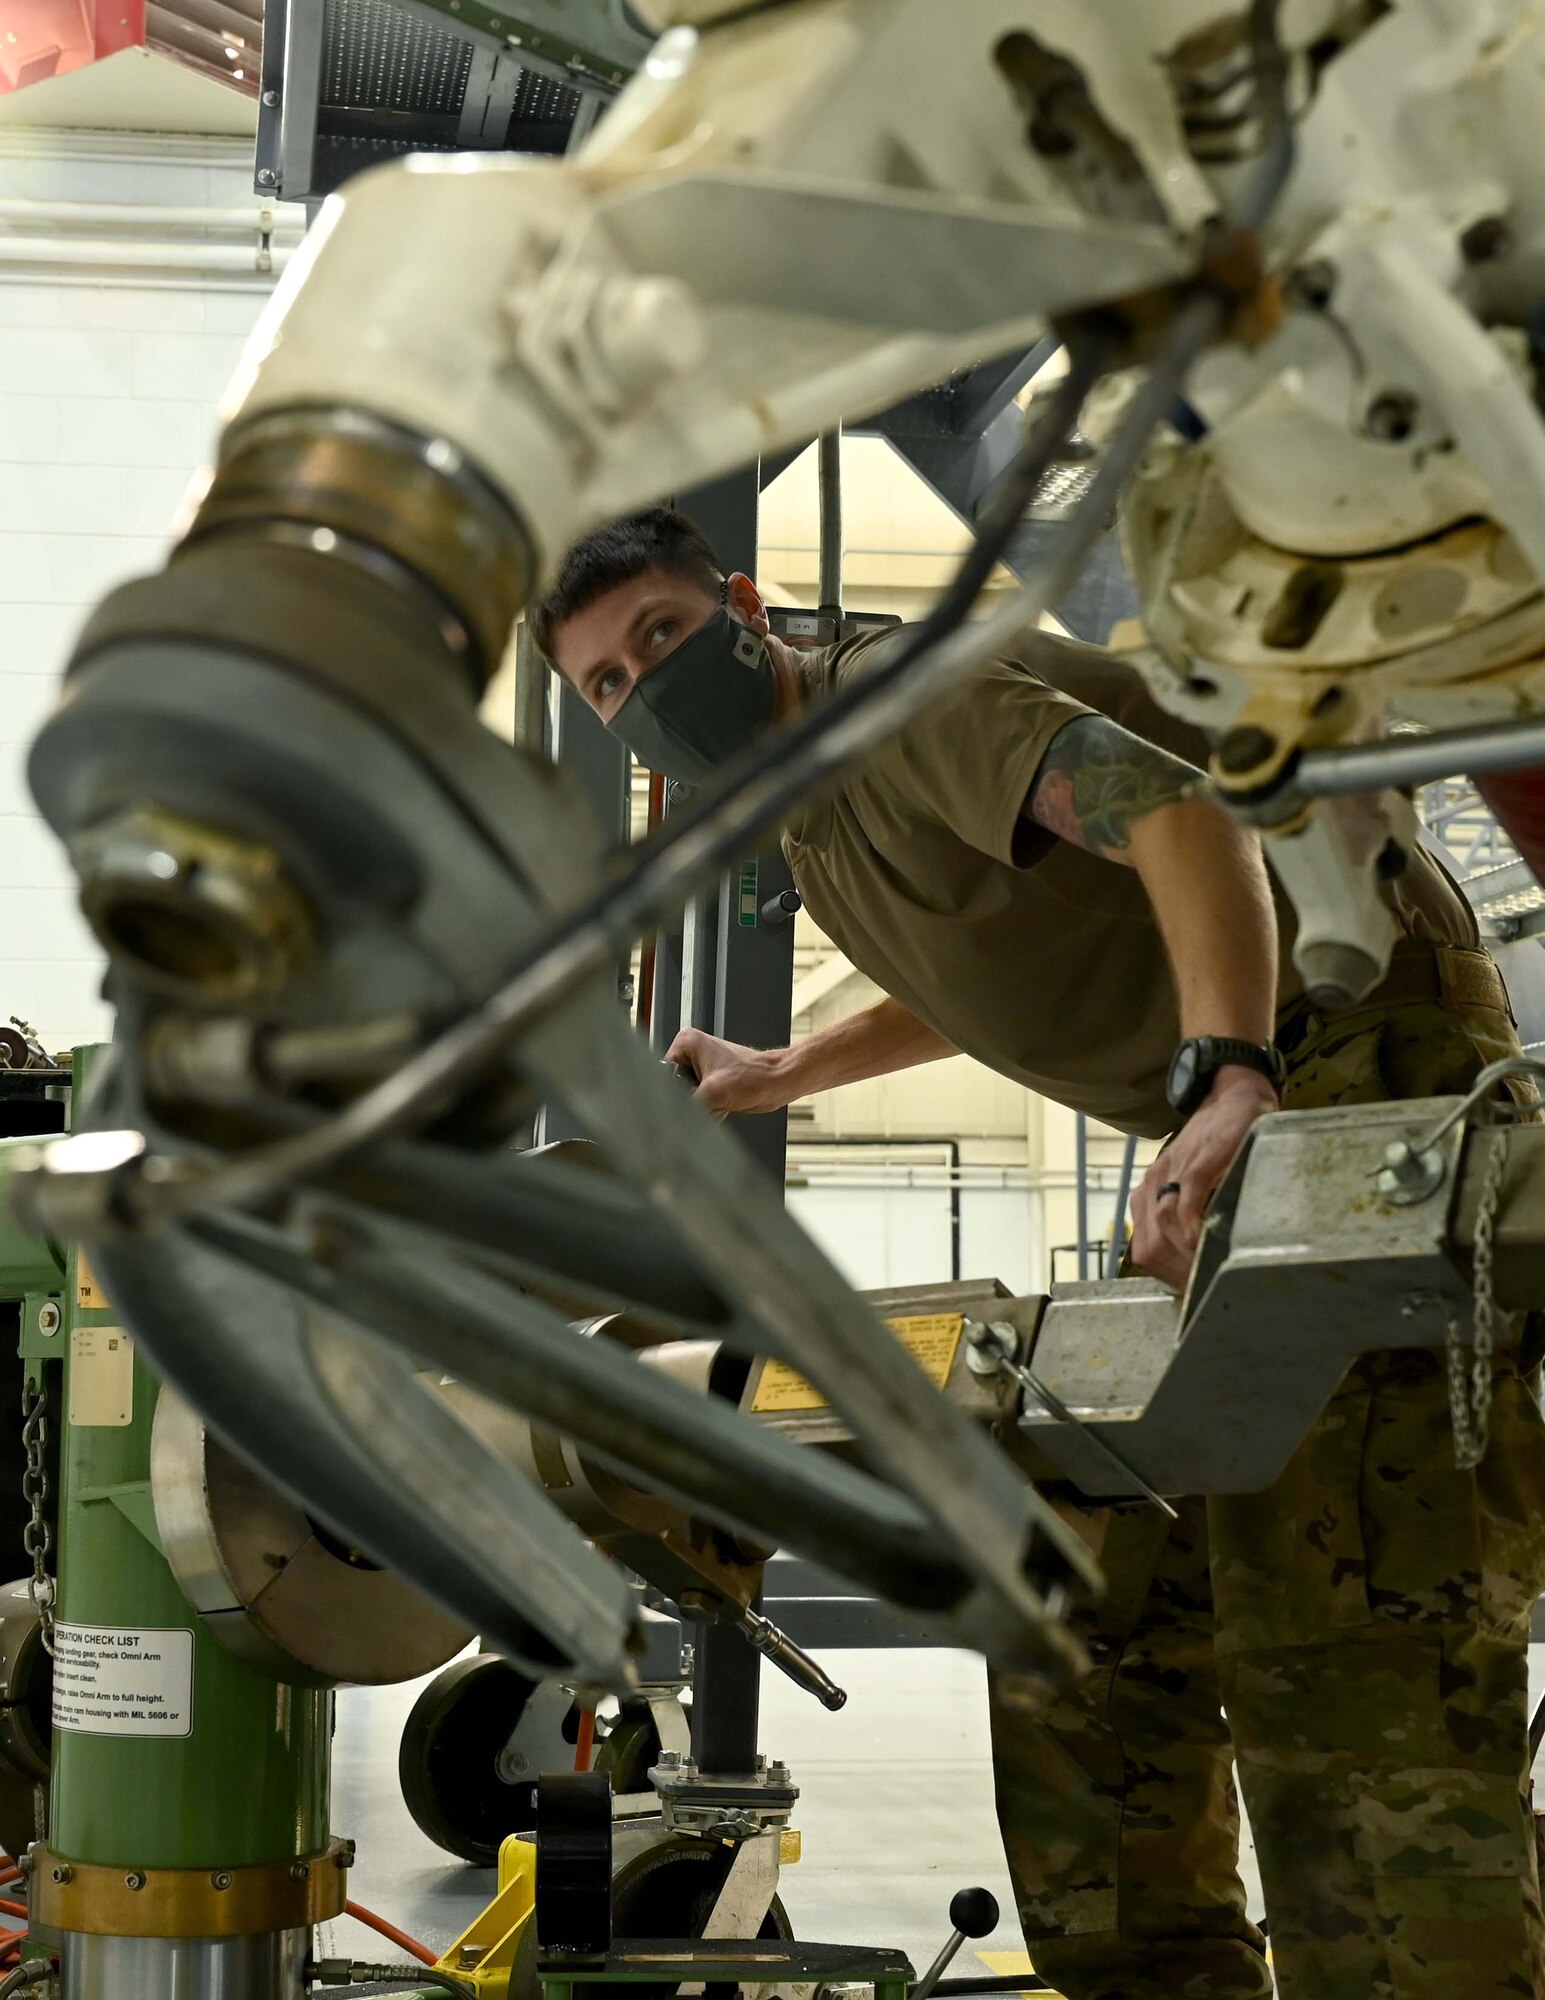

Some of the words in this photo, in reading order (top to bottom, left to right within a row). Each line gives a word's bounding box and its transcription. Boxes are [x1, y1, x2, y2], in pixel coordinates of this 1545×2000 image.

[80, 1287, 91, 1296] TM
[84, 1634, 115, 1646] CHECK
[117, 1636, 140, 1646] LIST
[99, 1650, 119, 1660] check
[120, 1651, 142, 1661] Omni
[143, 1652, 161, 1661] Arm
[80, 1673, 97, 1682] clean.
[80, 1690, 95, 1699] Omni
[96, 1692, 111, 1701] Arm
[112, 1693, 120, 1701] to
[121, 1693, 135, 1702] full
[136, 1694, 165, 1704] height.
[85, 1708, 112, 1719] housing
[113, 1710, 129, 1719] with
[131, 1711, 146, 1719] MIL
[148, 1711, 168, 1719] 5606
[169, 1712, 180, 1720] or
